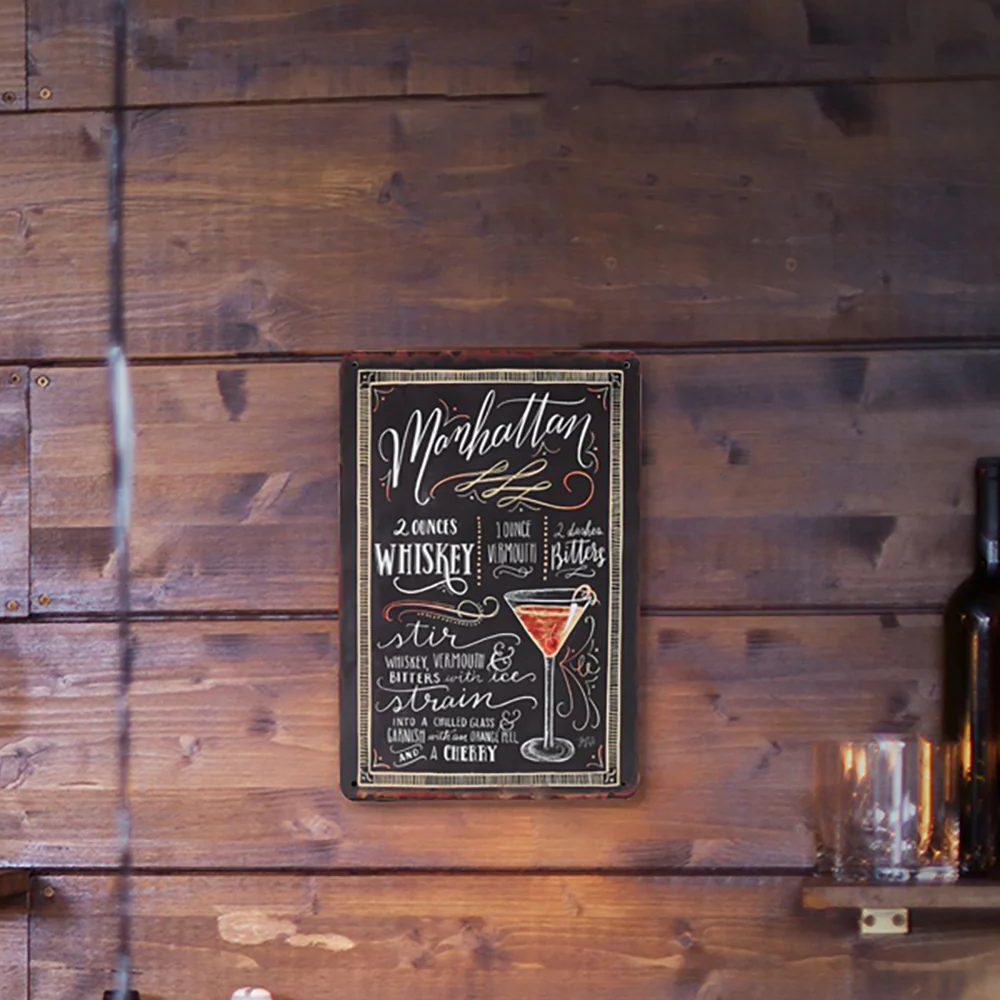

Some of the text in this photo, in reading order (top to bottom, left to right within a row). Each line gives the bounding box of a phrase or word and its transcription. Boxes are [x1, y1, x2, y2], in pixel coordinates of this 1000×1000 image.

[378, 389, 594, 505] Manhattan
[393, 517, 458, 536] 2 OUNCES
[502, 519, 532, 538] OUNCE
[553, 521, 565, 538] 2
[487, 542, 537, 563] VERMOUTH
[550, 538, 607, 571] Bitters
[374, 542, 475, 594] WHISKEY
[432, 652, 486, 669] VERMOUTH
[389, 670, 537, 684] BITTERS with ice
[374, 684, 538, 714] strain
[392, 716, 416, 727] INTO
[420, 716, 428, 727] A
[432, 716, 467, 728] CHILLED
[469, 716, 495, 728] GLASS
[386, 727, 426, 744] GARNISH
[399, 744, 498, 762] AND A CHERRY
